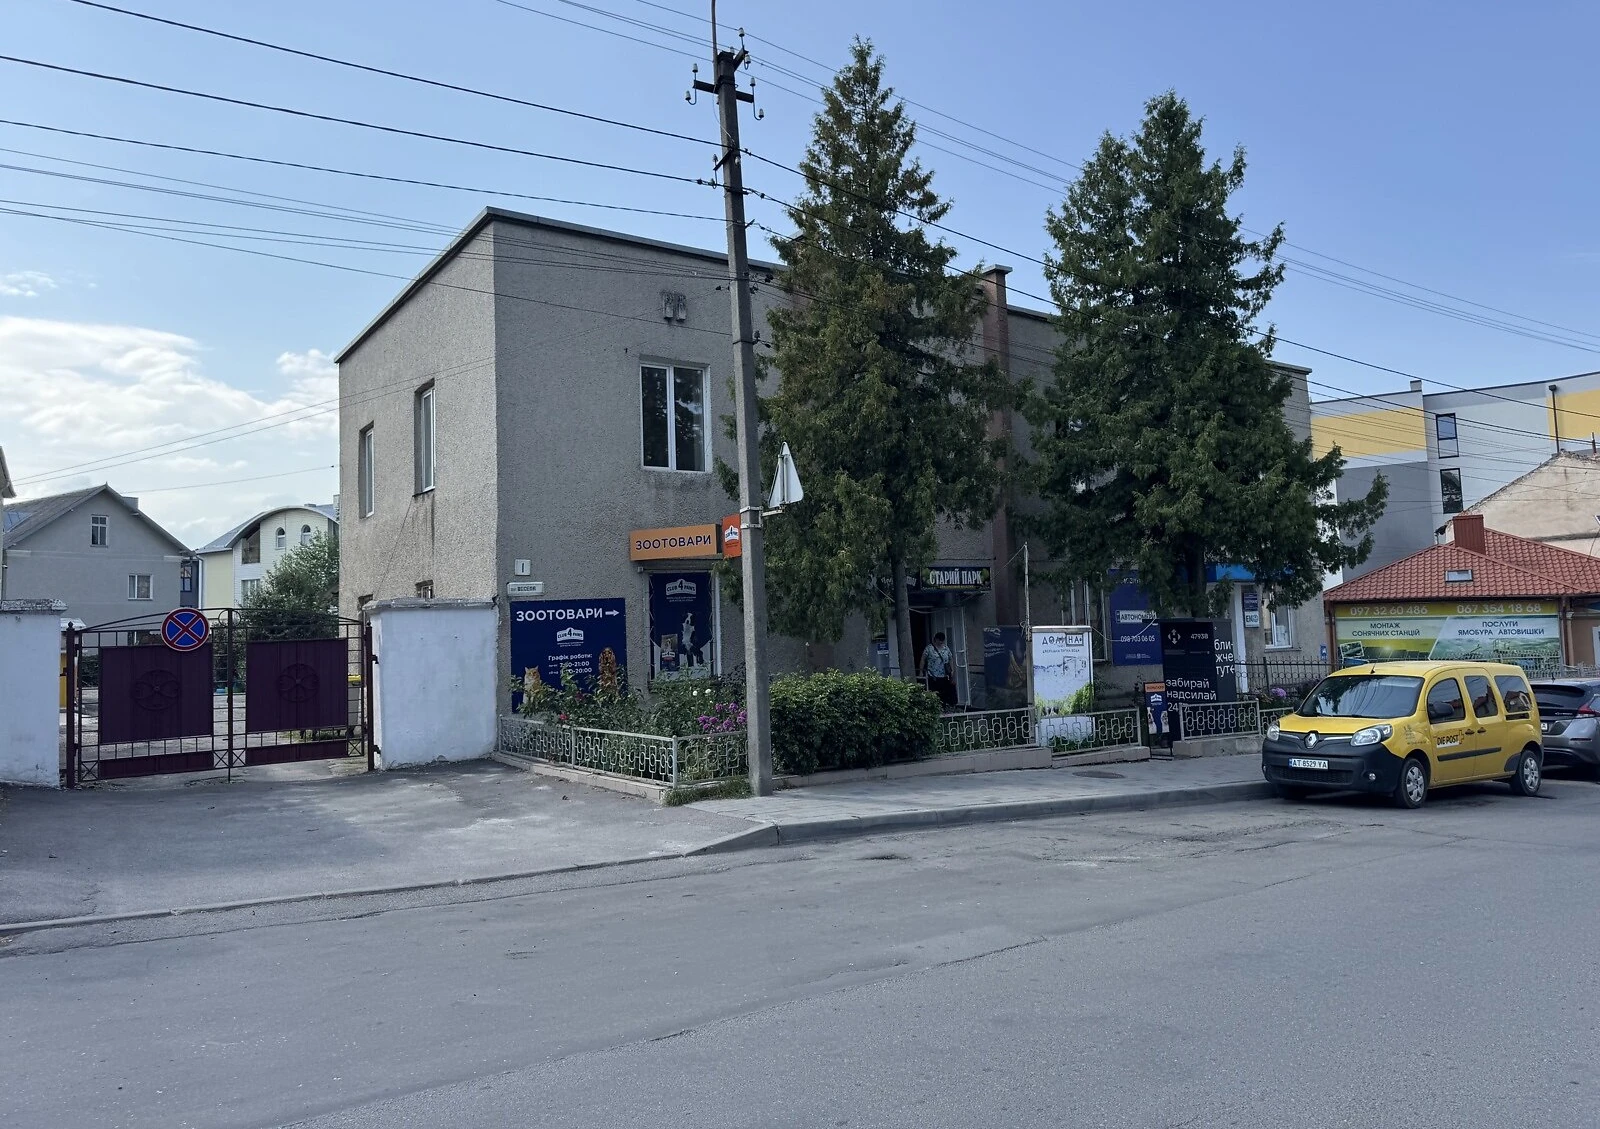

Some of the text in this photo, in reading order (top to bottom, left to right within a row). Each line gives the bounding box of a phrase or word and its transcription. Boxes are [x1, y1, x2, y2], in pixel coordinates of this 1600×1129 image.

[635, 535, 711, 550] ЗООТОВАРИ
[929, 568, 960, 585] СТАРИЙ
[961, 570, 982, 585] ПАРК
[678, 580, 684, 591] 4
[1350, 605, 1429, 616] 097 32 60 486
[1456, 603, 1541, 614] 067 354 18 68
[516, 607, 603, 622] ЗООТОВАРИ
[1390, 628, 1420, 637] СТАНЦІЙ
[1498, 628, 1545, 636] АВТОВИШКИ
[1213, 639, 1234, 651] бли-
[1215, 652, 1234, 663] жче
[1165, 677, 1210, 689] забирай
[1166, 690, 1217, 701] надсилай
